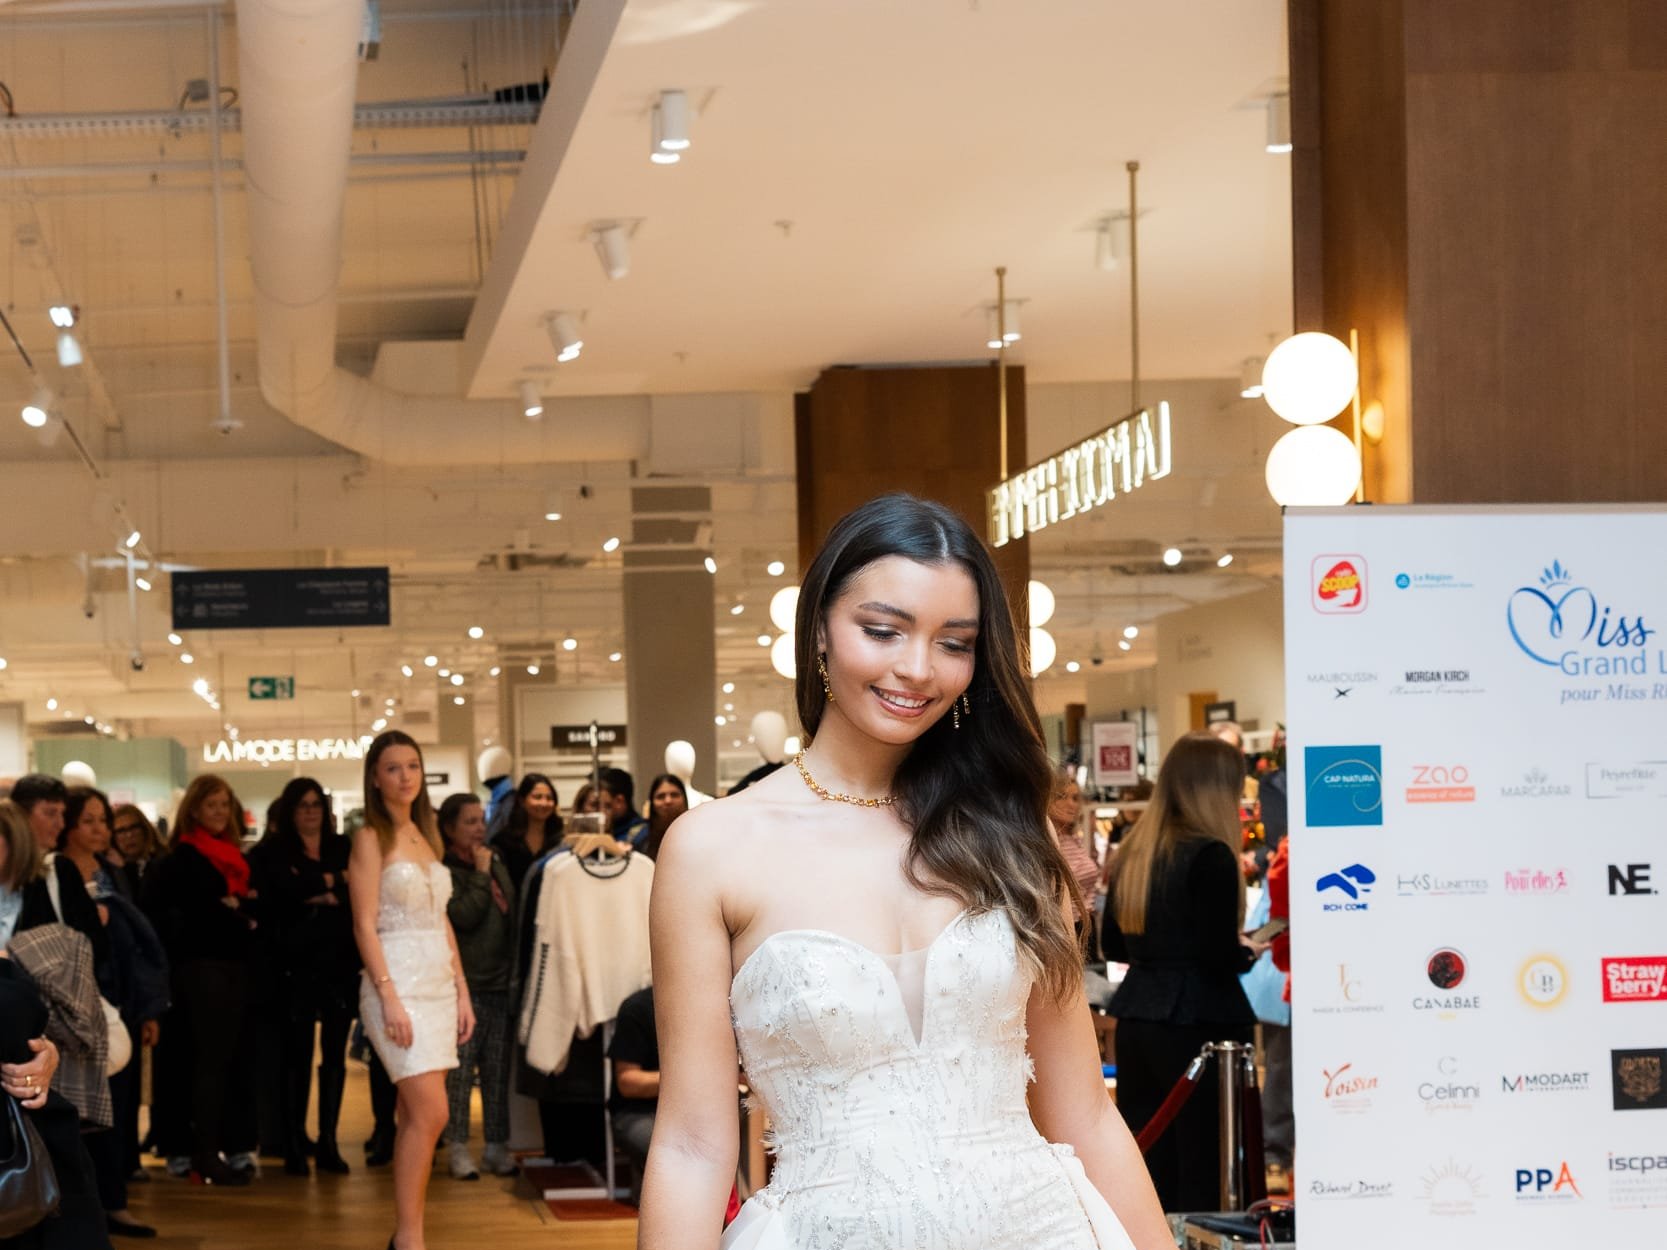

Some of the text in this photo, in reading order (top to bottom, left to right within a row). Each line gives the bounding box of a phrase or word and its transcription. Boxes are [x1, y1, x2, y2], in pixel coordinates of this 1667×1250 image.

[1507, 587, 1656, 667] Miss
[1560, 649, 1646, 676] Grand
[1307, 672, 1377, 684] MAUBOUSSIN
[1405, 669, 1470, 683] MORGAN KIRCH
[1560, 688, 1601, 705] pour
[1606, 684, 1647, 700] Miss
[203, 740, 232, 762] LA
[233, 739, 294, 761] MODE
[1324, 774, 1376, 784] CAP NATURA
[1606, 962, 1666, 979] Straw
[1525, 1072, 1589, 1086] MODART
[1516, 1161, 1584, 1200] PPA
